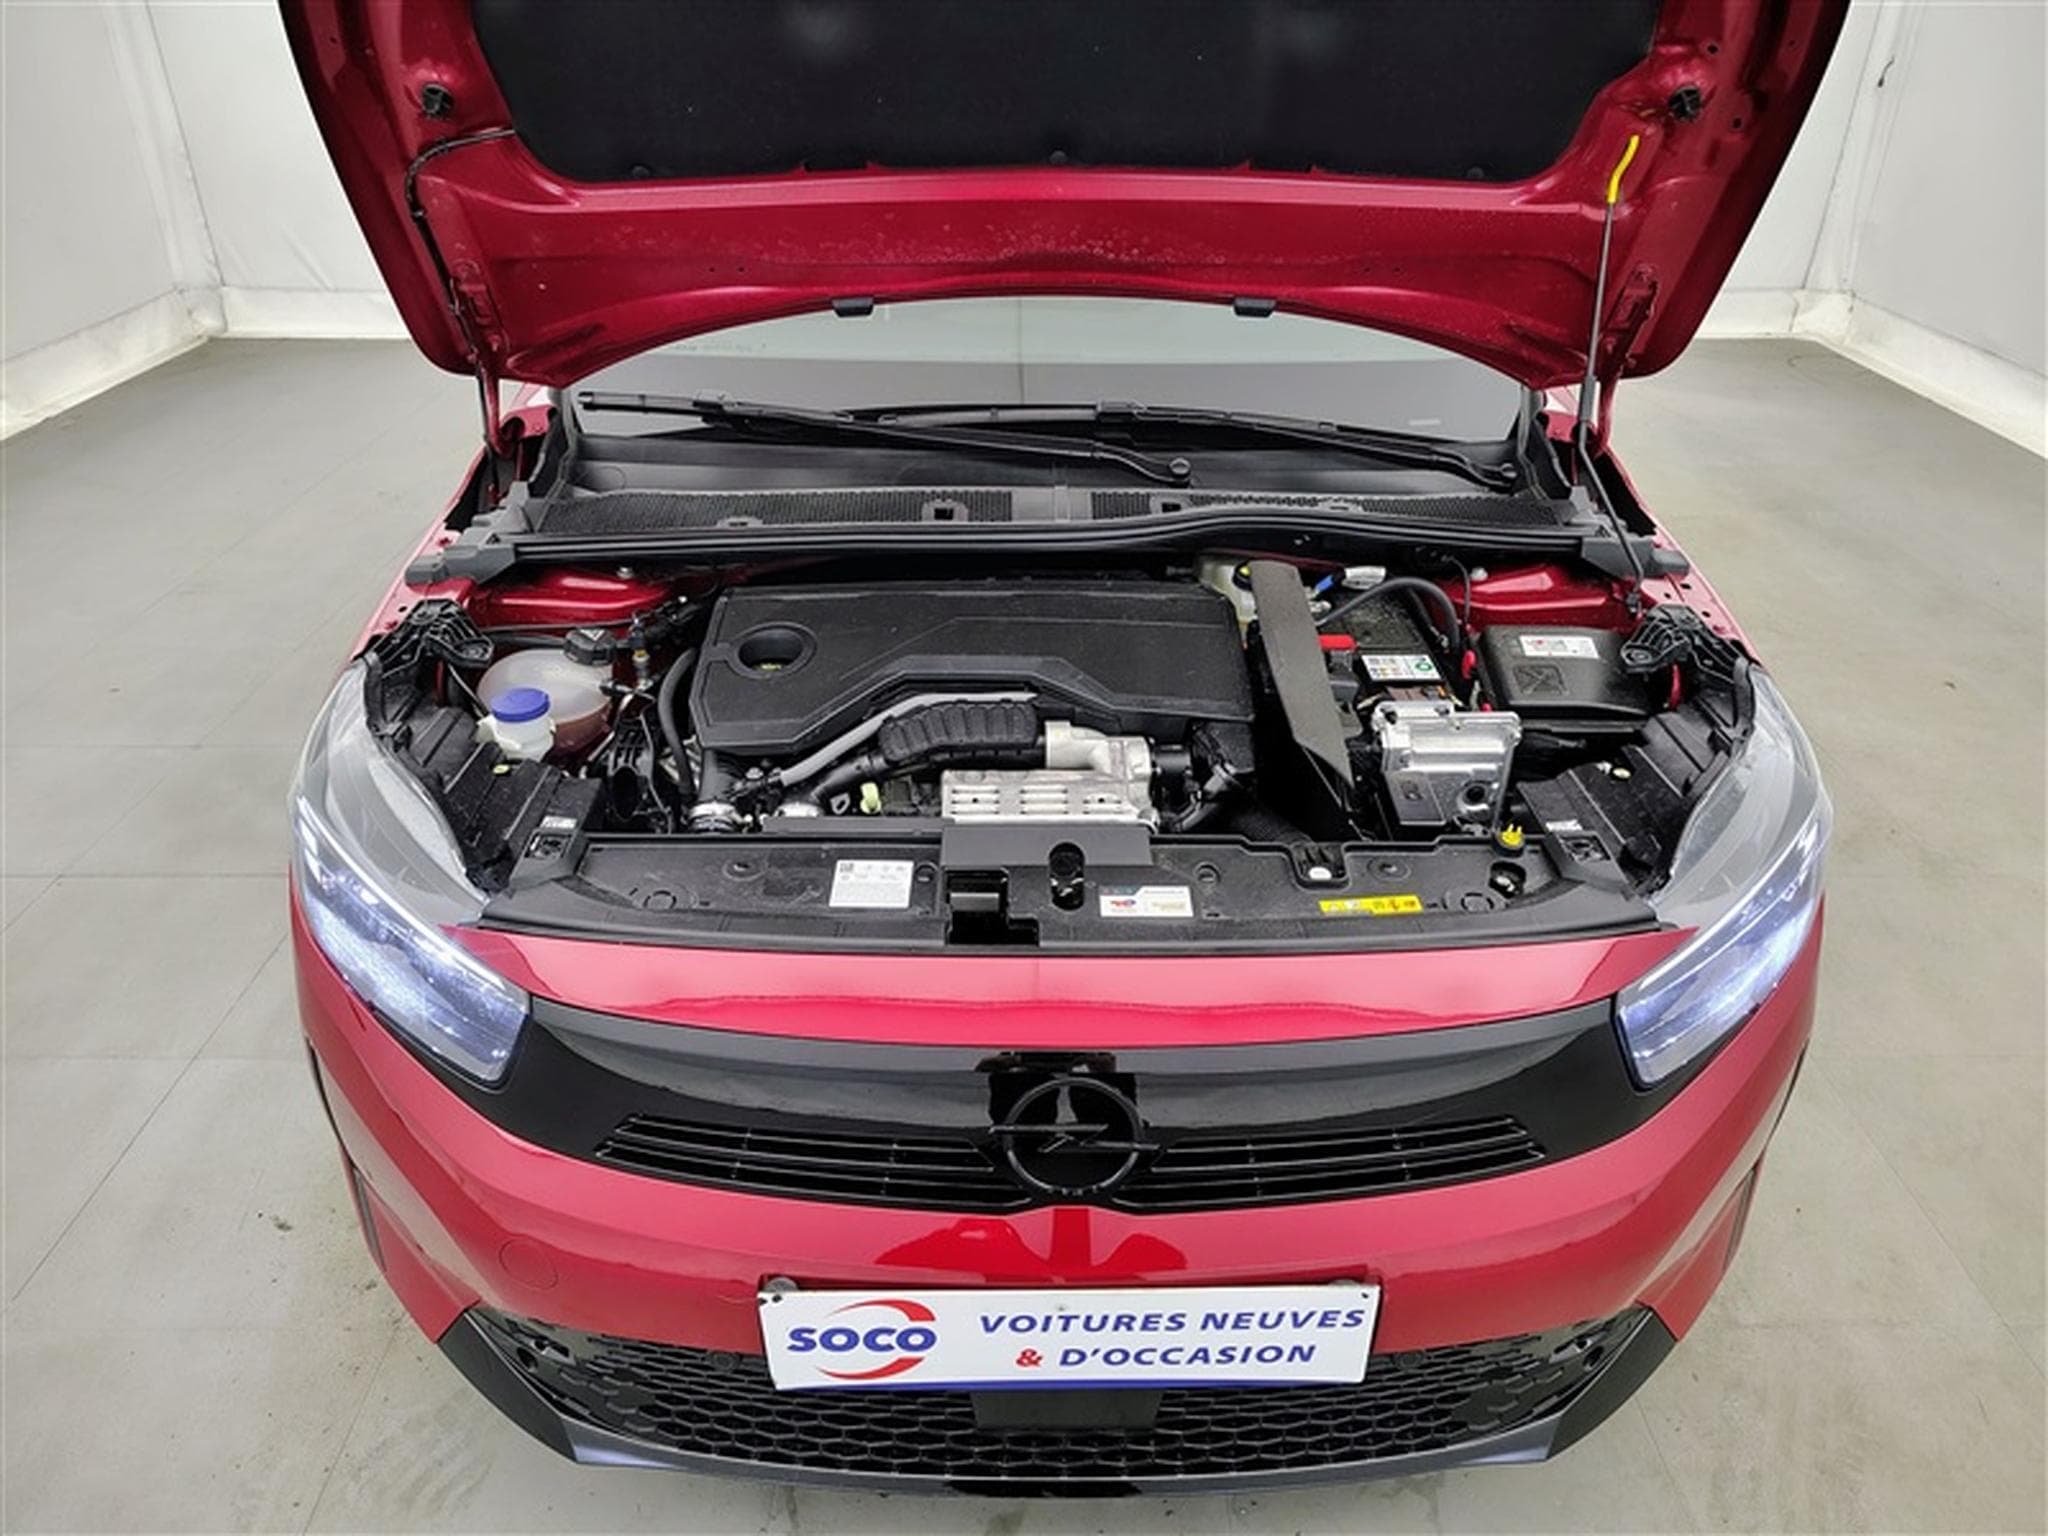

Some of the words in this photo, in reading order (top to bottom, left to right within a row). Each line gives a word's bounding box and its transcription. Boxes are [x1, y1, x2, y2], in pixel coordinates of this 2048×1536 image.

[980, 1311, 1187, 1334] VOITURES
[1200, 1308, 1366, 1331] NEUVES
[787, 1325, 938, 1354] SOCO
[1015, 1348, 1043, 1368] &
[1059, 1344, 1316, 1367] D'OCCASION
